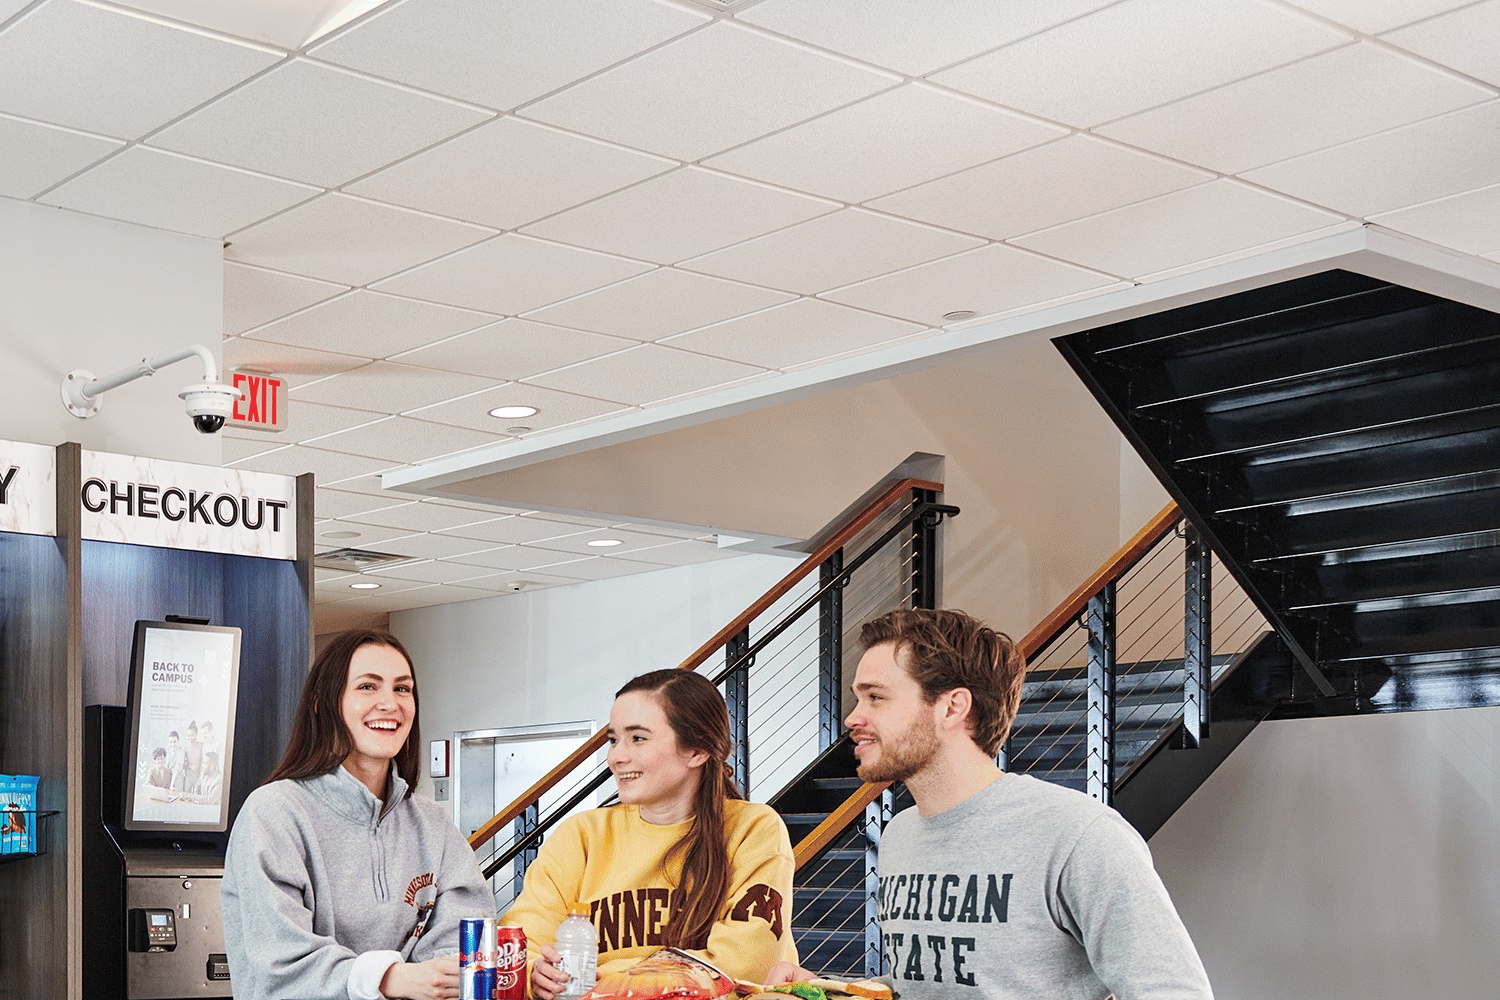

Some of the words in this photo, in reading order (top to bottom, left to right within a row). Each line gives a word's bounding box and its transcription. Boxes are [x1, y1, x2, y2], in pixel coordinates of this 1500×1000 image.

[233, 373, 281, 425] EXIT
[81, 476, 288, 533] CHECKOUT
[151, 672, 194, 684] CAMPUS
[152, 661, 180, 672] BACK
[181, 663, 195, 673] TO
[883, 933, 977, 987] TATE
[497, 975, 509, 985] 23
